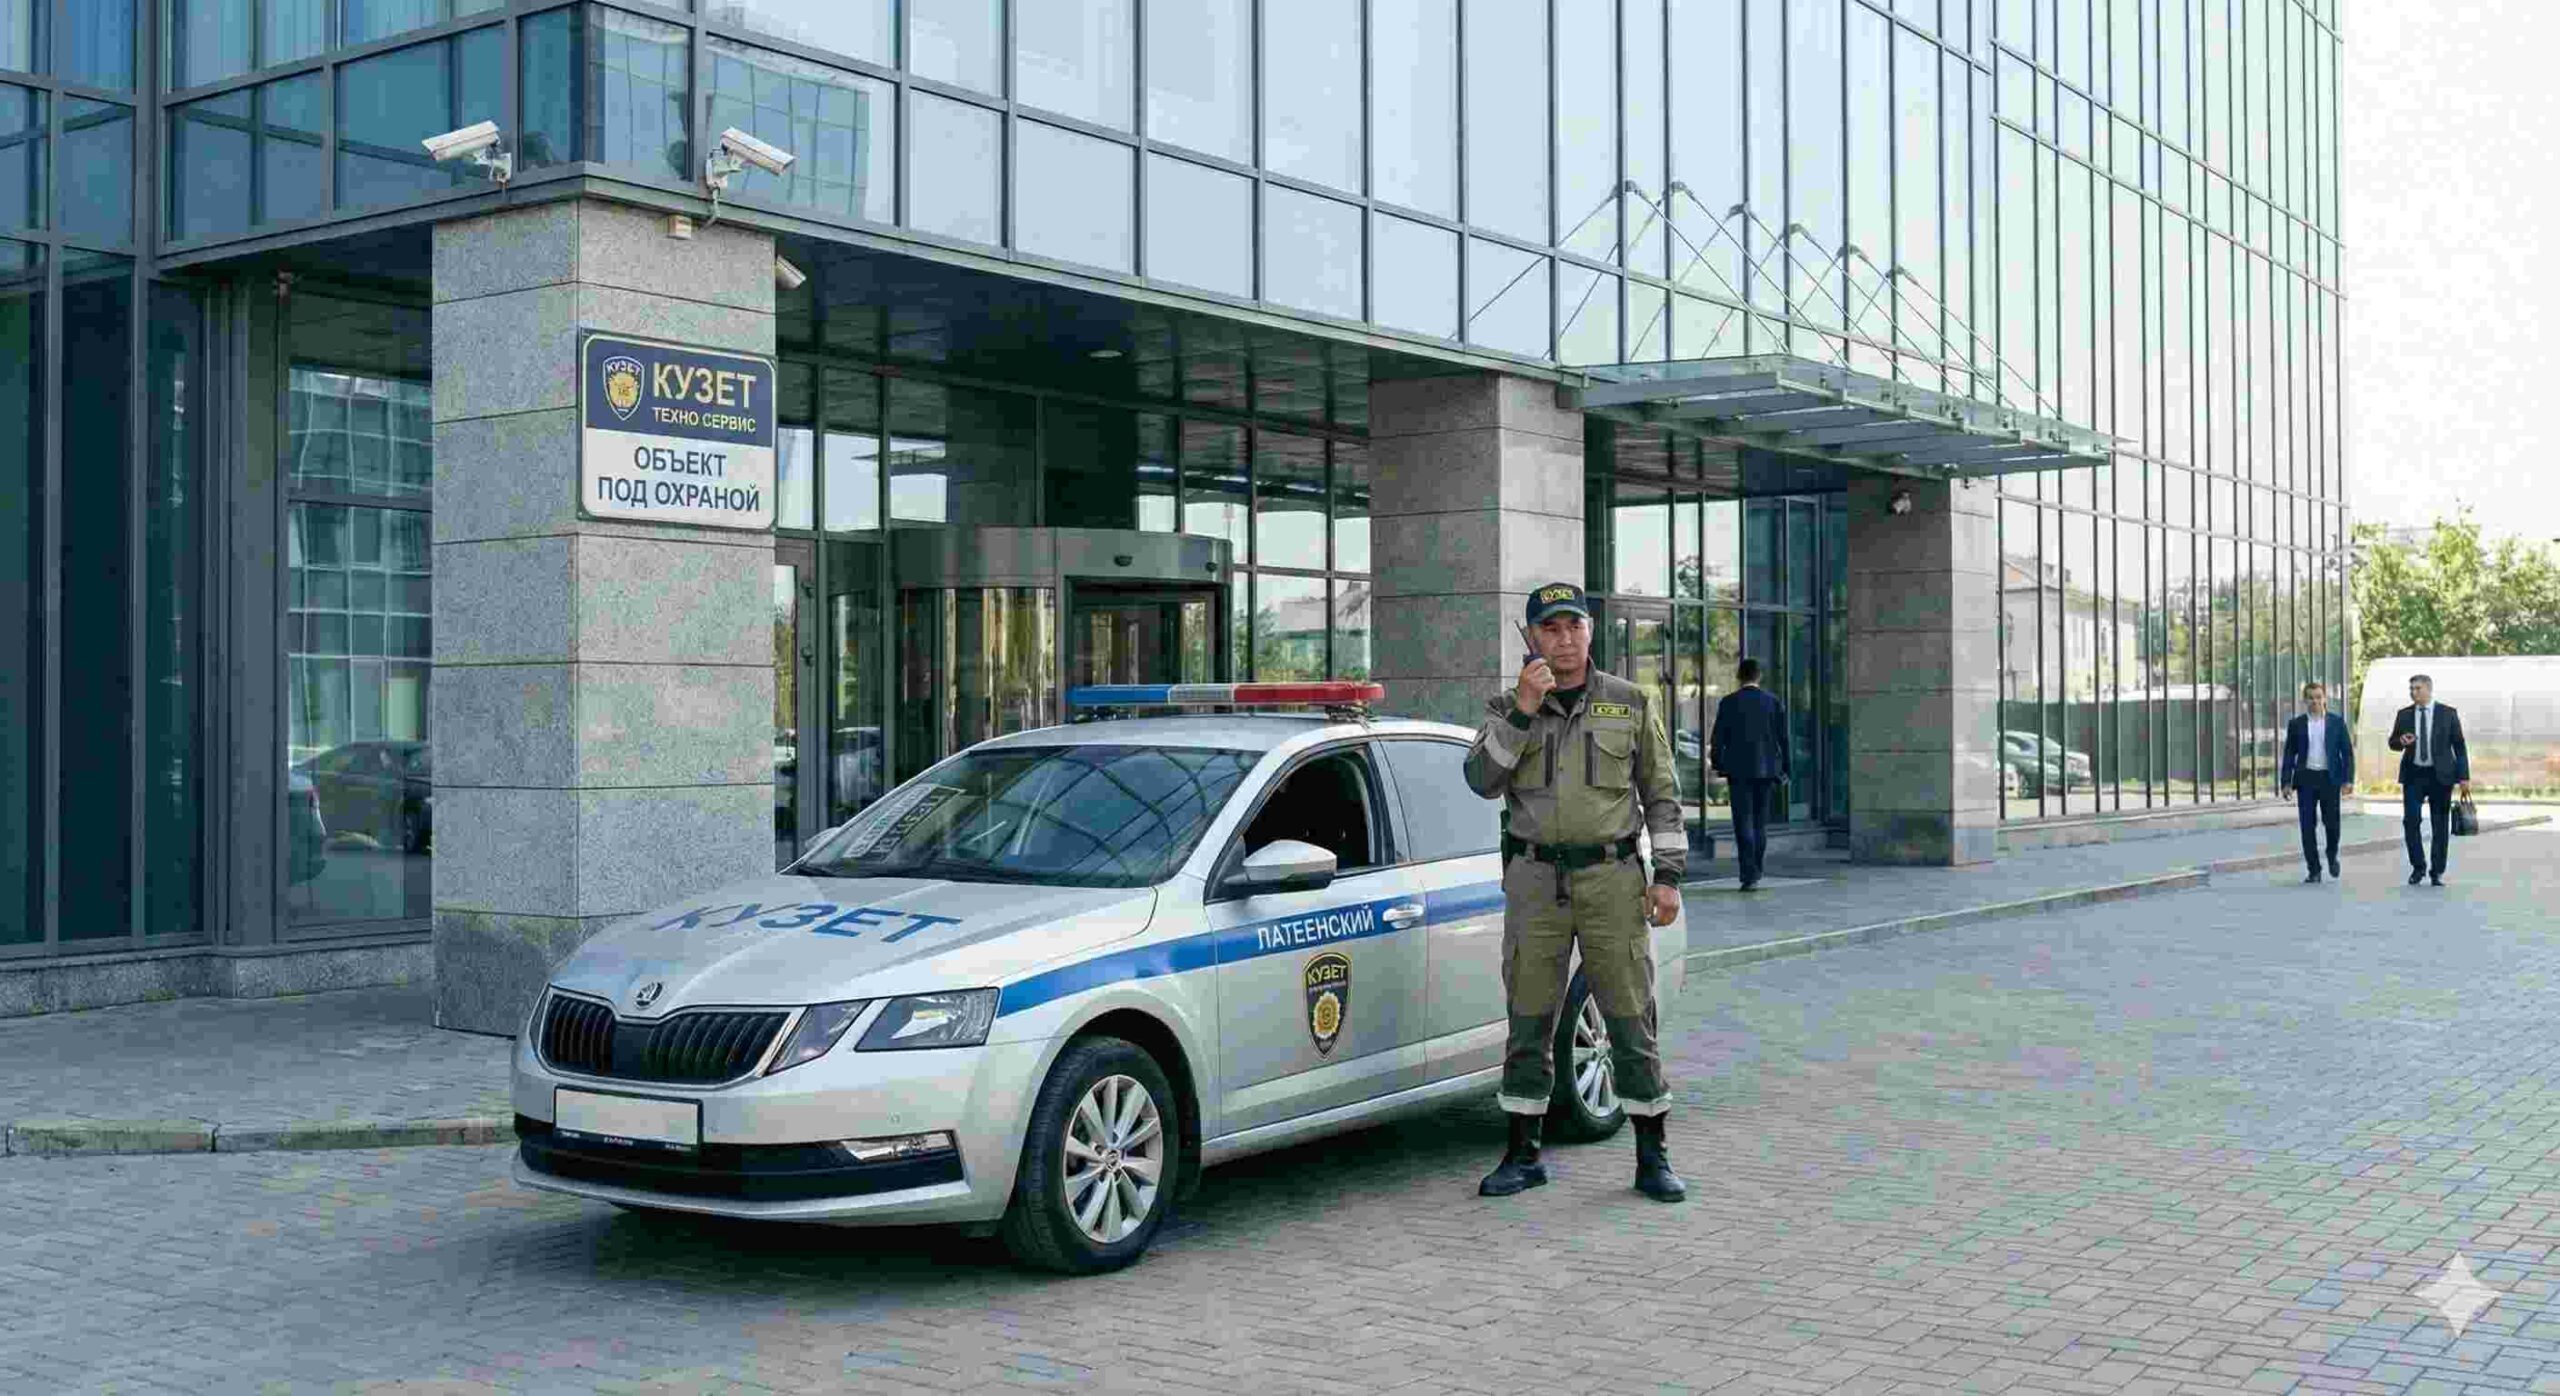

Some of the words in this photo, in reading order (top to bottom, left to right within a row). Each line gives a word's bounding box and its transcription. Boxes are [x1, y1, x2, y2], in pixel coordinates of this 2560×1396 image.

[606, 360, 641, 375] КУЗЕТ
[653, 362, 757, 408] КУЗЕТ
[652, 406, 699, 426] ТЕХНО
[702, 414, 757, 433] СЕРВИС
[634, 445, 727, 477] ОБЪЕКТ
[598, 476, 648, 508] ПОД
[654, 480, 760, 512] ОХРАНОЙ
[650, 902, 963, 943] КУЗЕТ
[1307, 964, 1347, 985] КУЗЕТ
